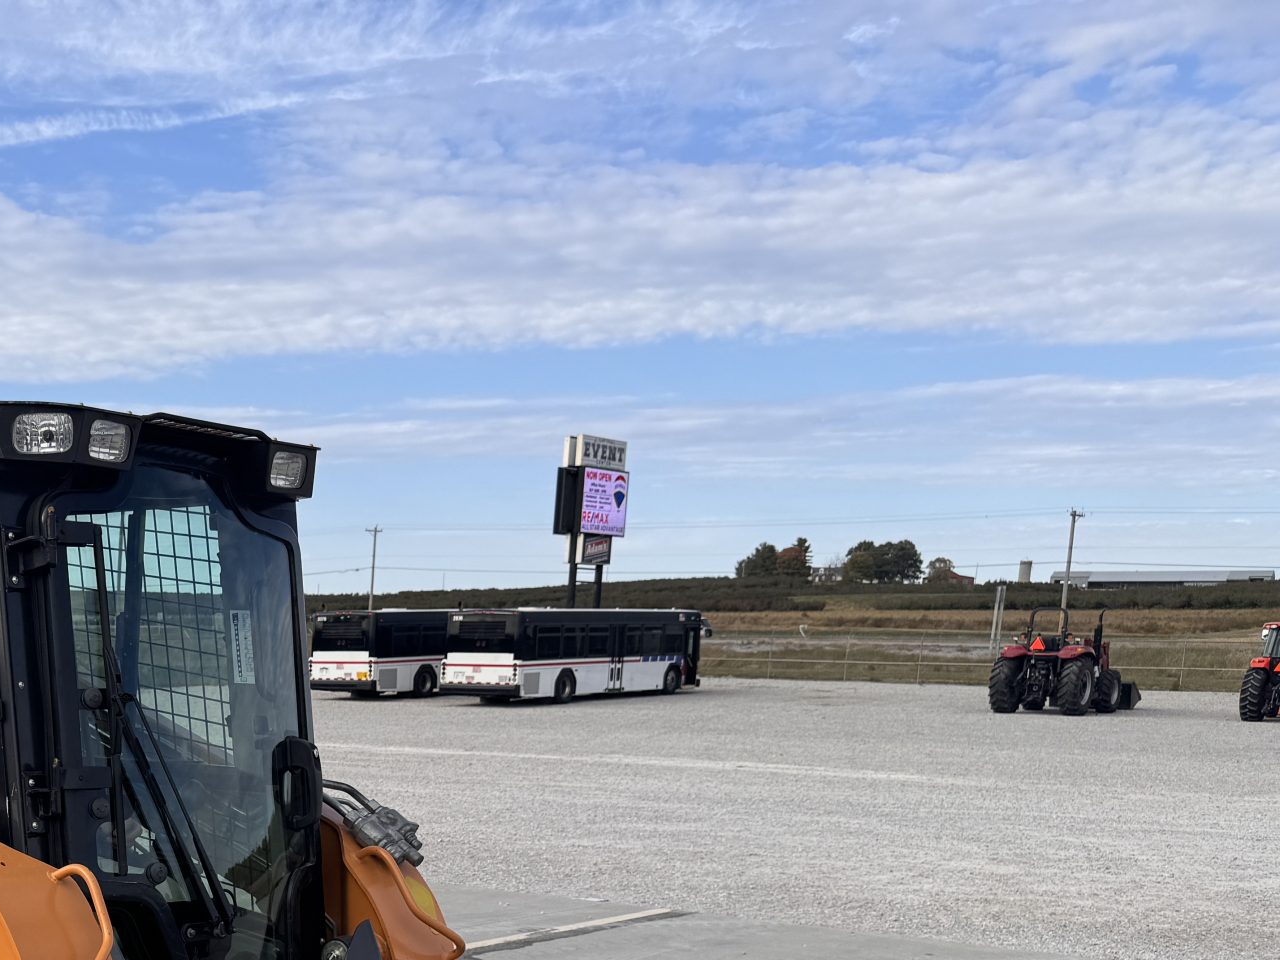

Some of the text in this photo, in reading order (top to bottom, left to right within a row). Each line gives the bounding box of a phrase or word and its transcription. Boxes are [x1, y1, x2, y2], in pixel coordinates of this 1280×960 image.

[583, 442, 625, 463] EVENT
[598, 472, 612, 482] OPEN
[582, 511, 609, 524] RE/MAX
